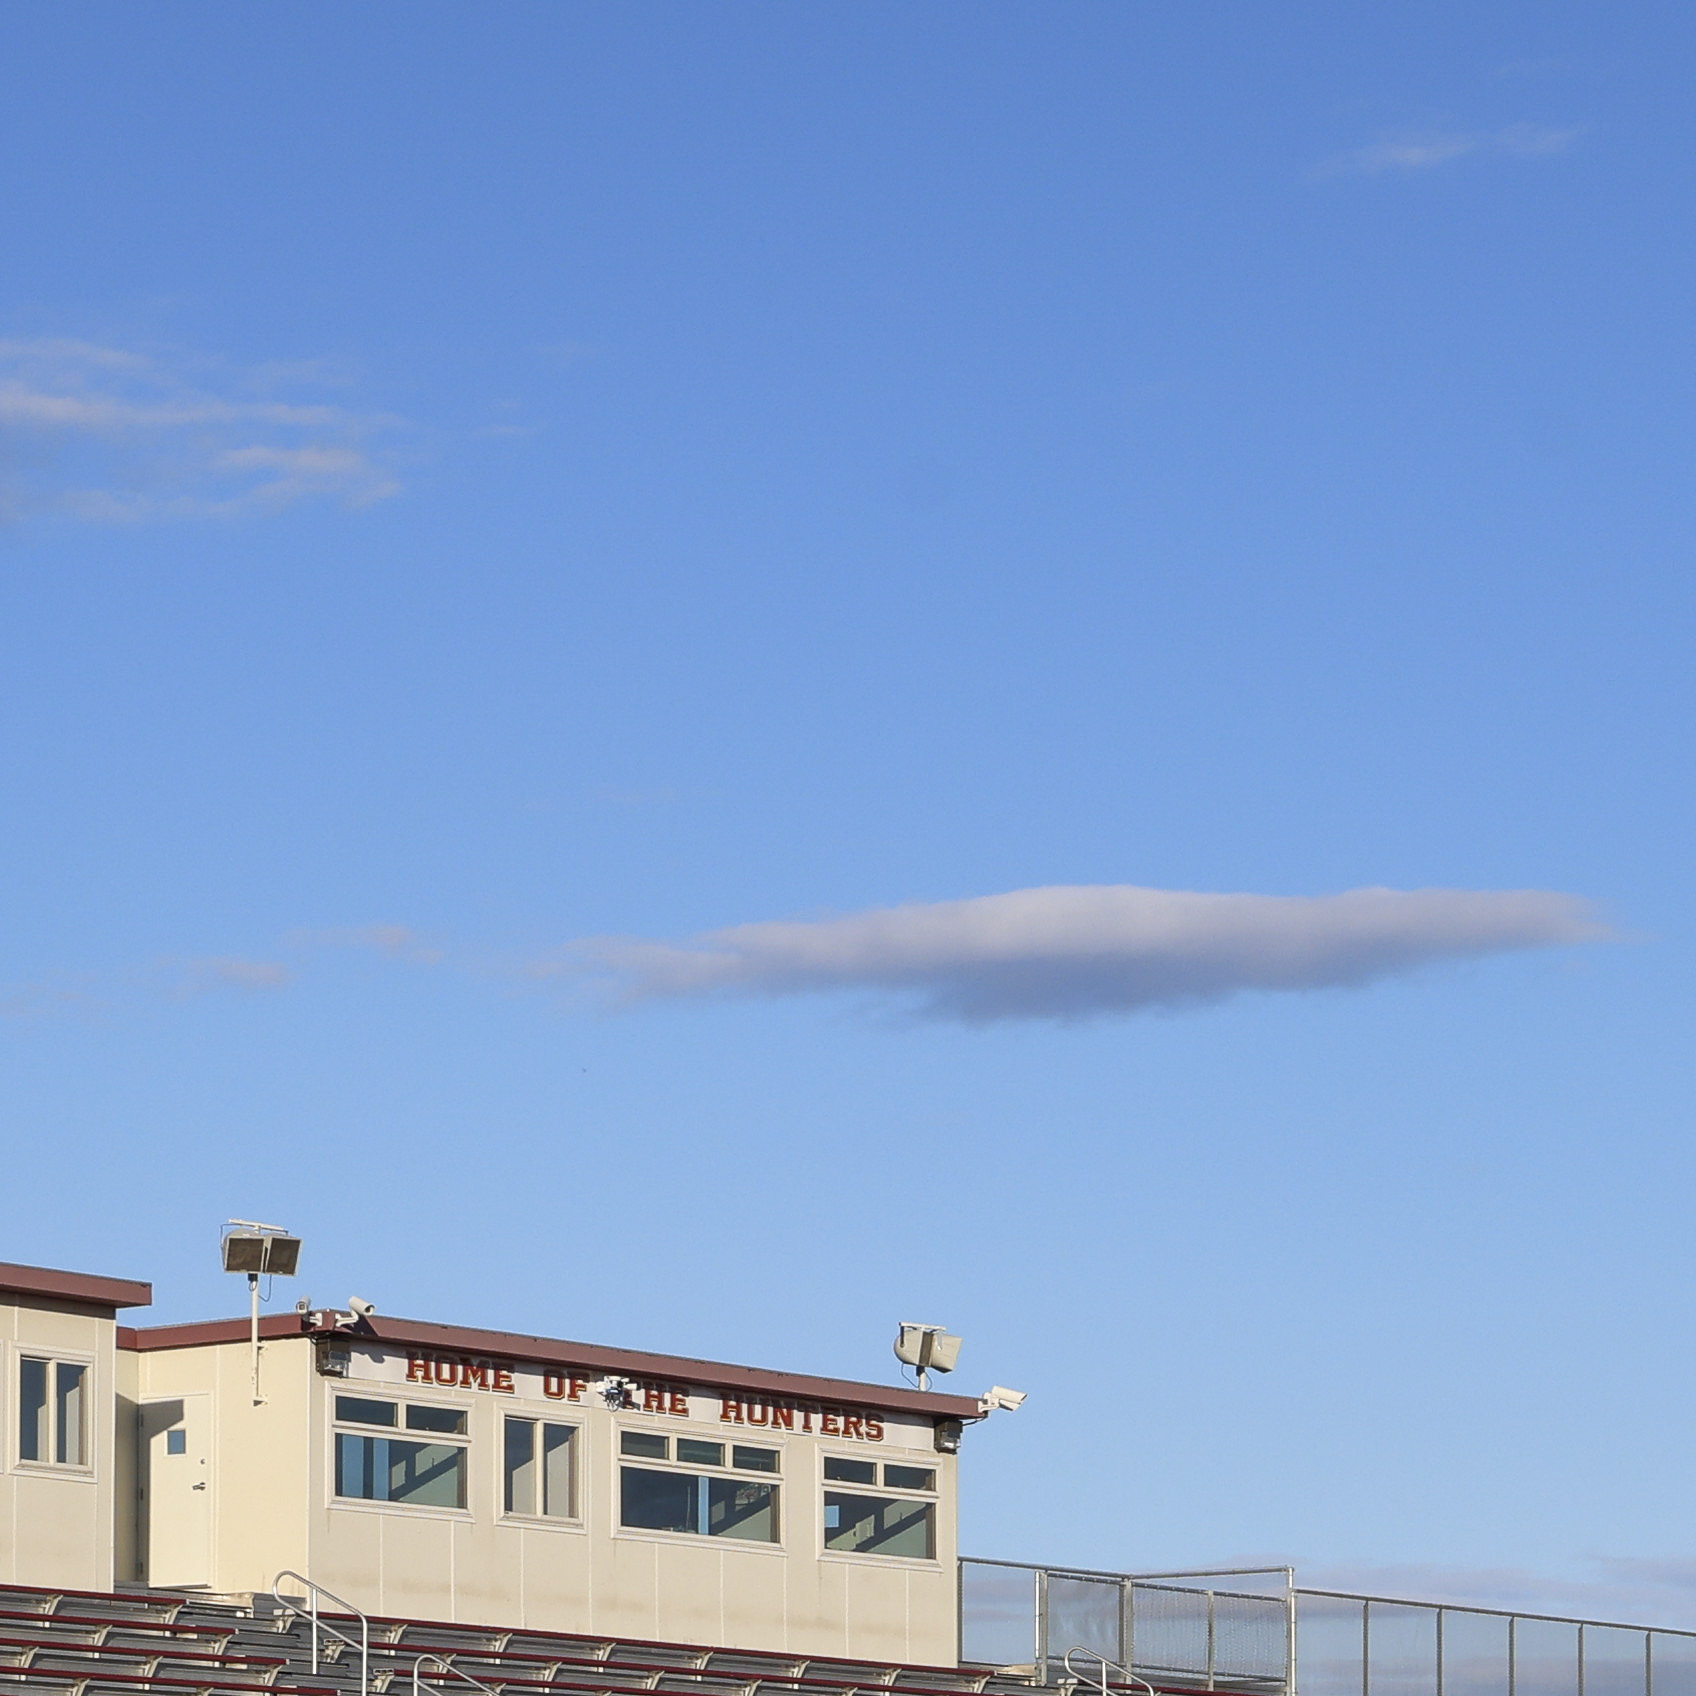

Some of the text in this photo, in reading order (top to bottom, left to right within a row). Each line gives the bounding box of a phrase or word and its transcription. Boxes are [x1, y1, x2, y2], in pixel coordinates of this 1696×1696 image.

[406, 1350, 515, 1394] HOME
[543, 1366, 590, 1402] OF
[720, 1391, 885, 1441] HUNTERS
